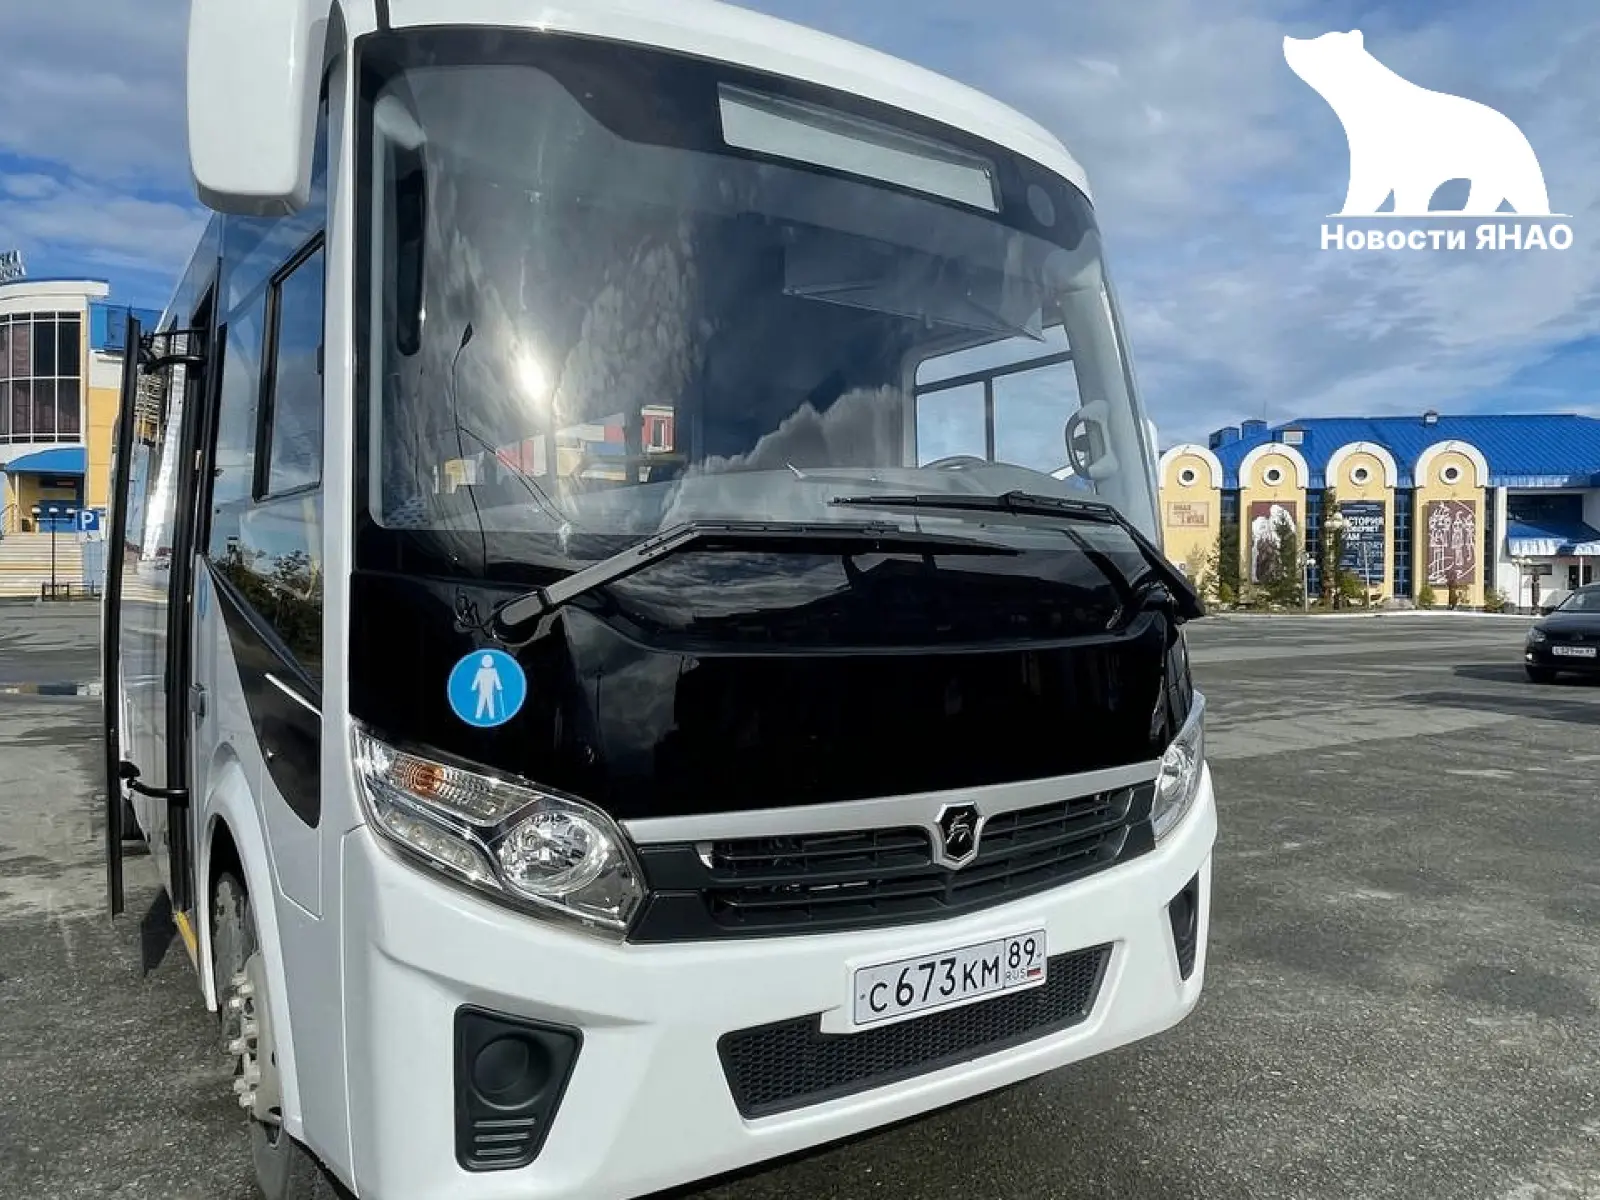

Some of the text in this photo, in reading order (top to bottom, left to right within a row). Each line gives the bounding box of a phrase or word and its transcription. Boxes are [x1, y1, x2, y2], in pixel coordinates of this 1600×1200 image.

[81, 511, 95, 530] P
[869, 937, 1036, 1012] С673КМ 89
[1006, 968, 1026, 981] RUS
